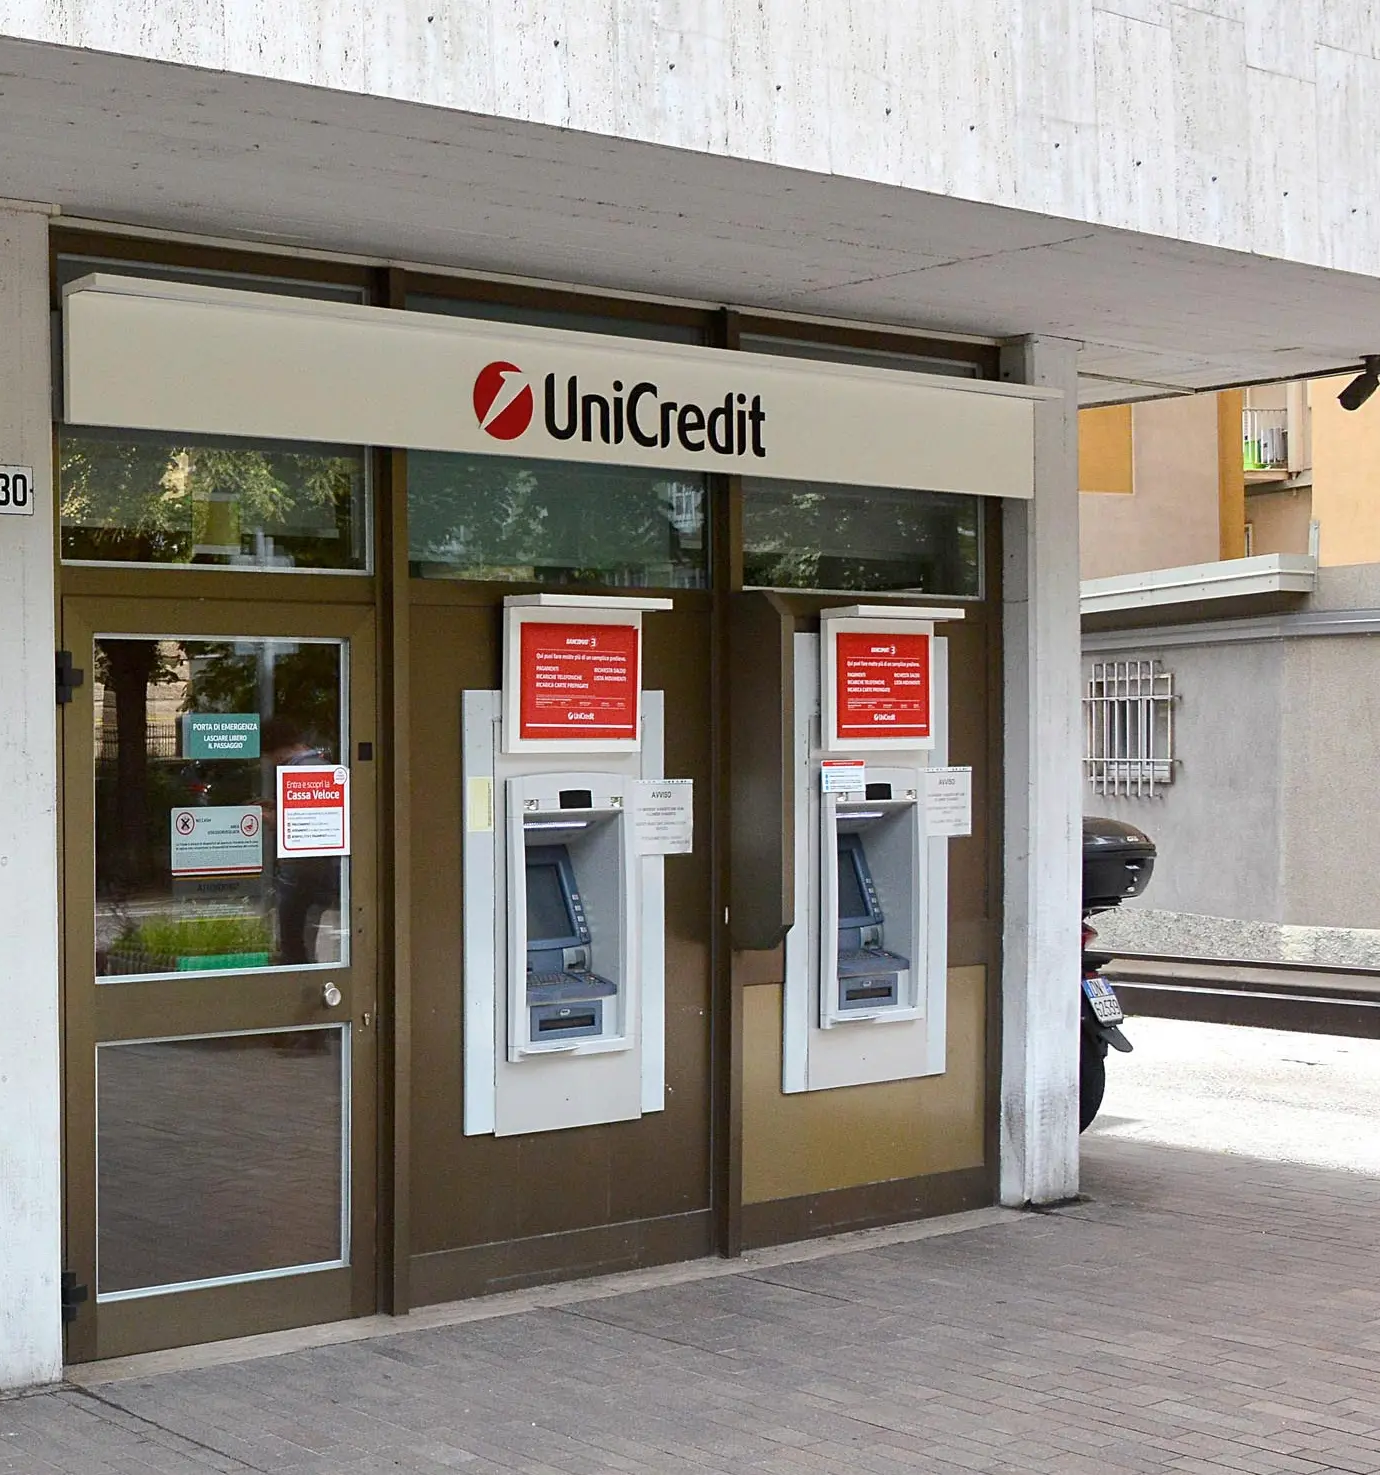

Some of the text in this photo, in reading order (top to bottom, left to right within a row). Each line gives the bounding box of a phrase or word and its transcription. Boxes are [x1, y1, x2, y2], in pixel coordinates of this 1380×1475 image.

[544, 372, 766, 458] UniCredit
[574, 712, 595, 721] UniCredit
[192, 723, 258, 731] PORTA DI EMERGENZA
[228, 734, 248, 742] LIBERO
[286, 780, 302, 789] Entra
[306, 780, 325, 790] scopri
[324, 780, 330, 788] la
[286, 788, 340, 800] Cassa Veloce
[651, 791, 672, 799] AVVISO
